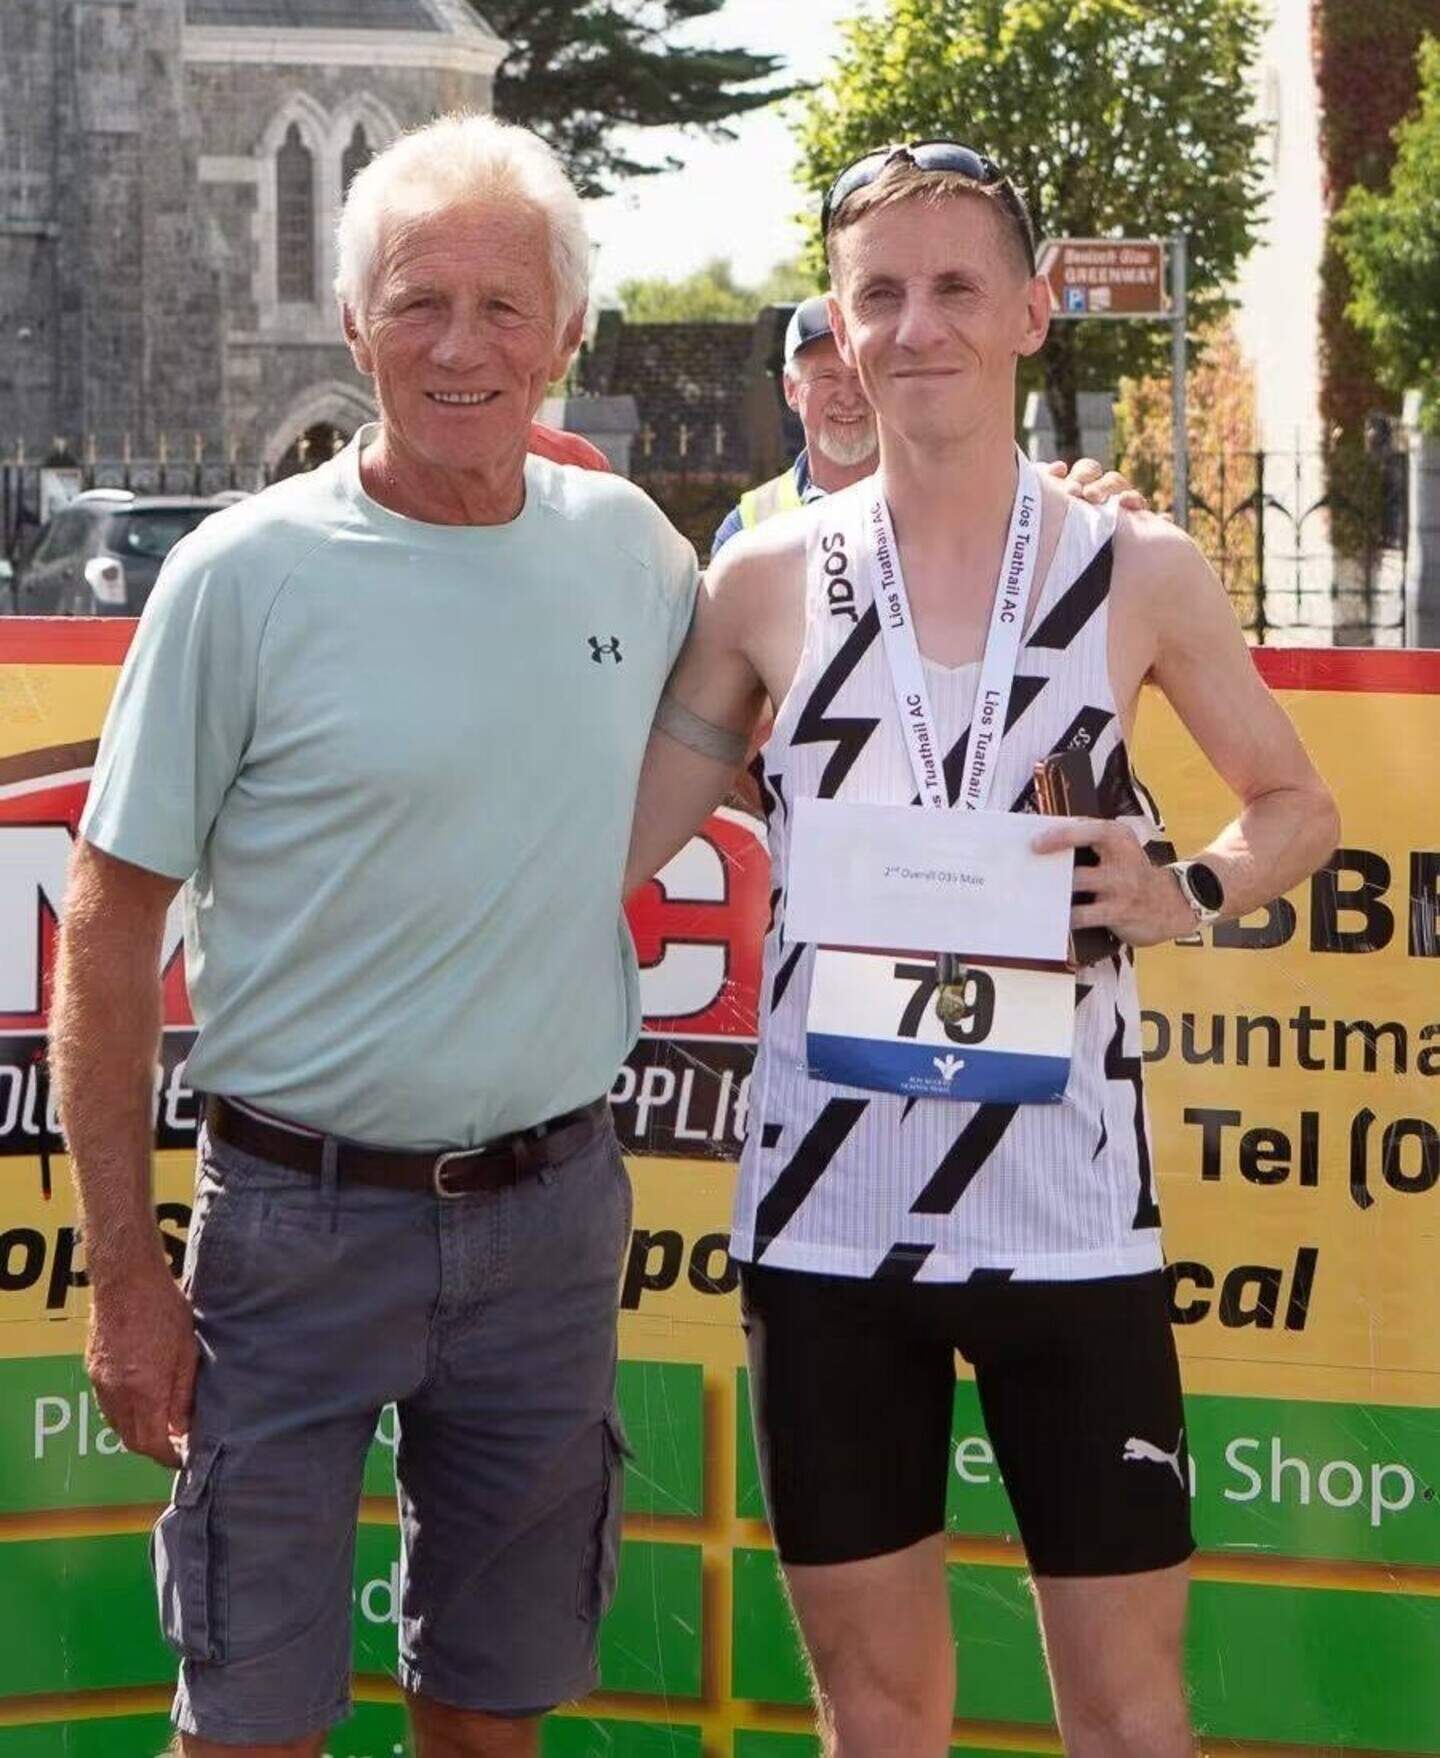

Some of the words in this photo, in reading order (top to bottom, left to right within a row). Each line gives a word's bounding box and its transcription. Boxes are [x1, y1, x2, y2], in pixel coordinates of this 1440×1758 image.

[1019, 495, 1034, 528] Lios
[822, 532, 858, 622] soar
[876, 527, 896, 590] Tuathail
[1006, 534, 1031, 596] Tuathail
[888, 593, 904, 628] Lios
[1000, 599, 1017, 623] AC
[907, 694, 924, 718] AC
[981, 690, 1000, 725] Lios
[913, 722, 938, 789] Tuathail
[968, 732, 993, 798] Tuathail
[895, 962, 996, 1045] 79
[1183, 1107, 1320, 1187] Tel
[1223, 1437, 1415, 1527] Shop
